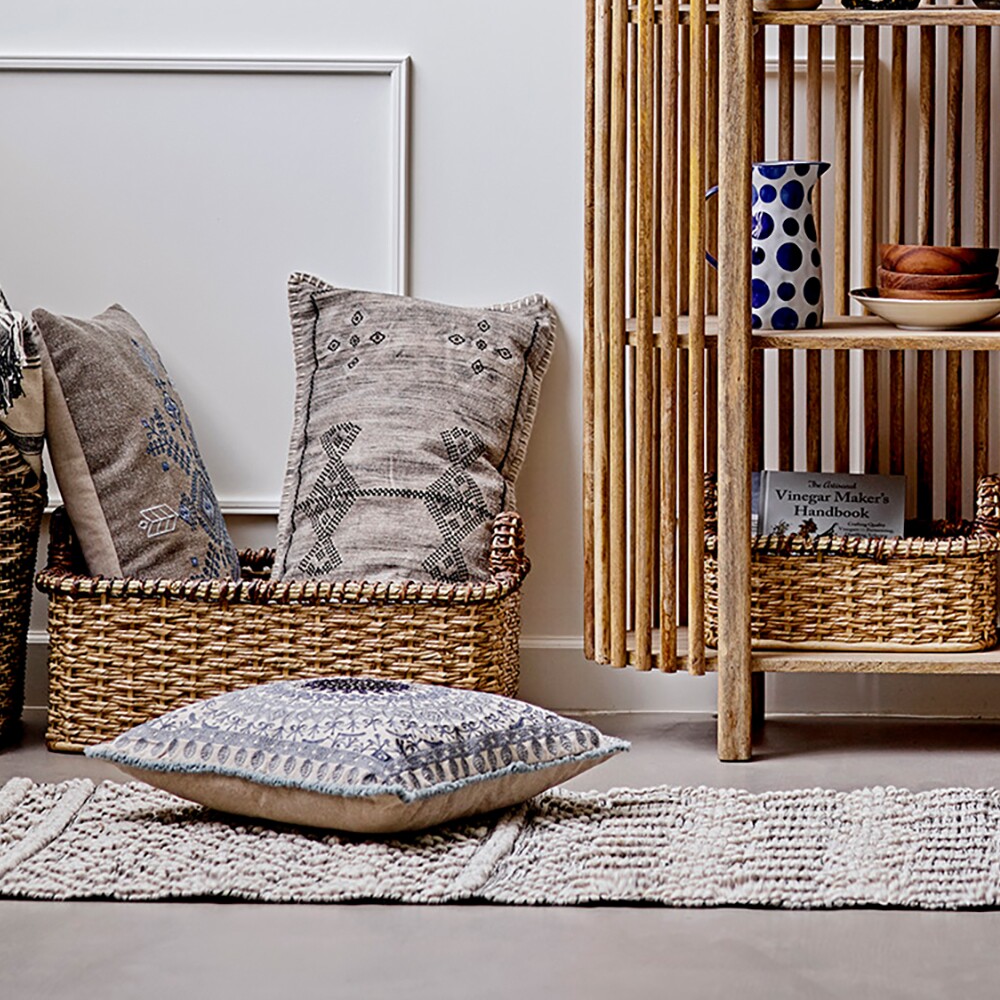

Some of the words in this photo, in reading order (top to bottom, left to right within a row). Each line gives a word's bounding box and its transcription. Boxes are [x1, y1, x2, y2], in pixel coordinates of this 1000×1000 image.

[775, 489, 831, 504] Vinegar
[834, 491, 890, 504] Maker's
[794, 505, 870, 519] Handbook
